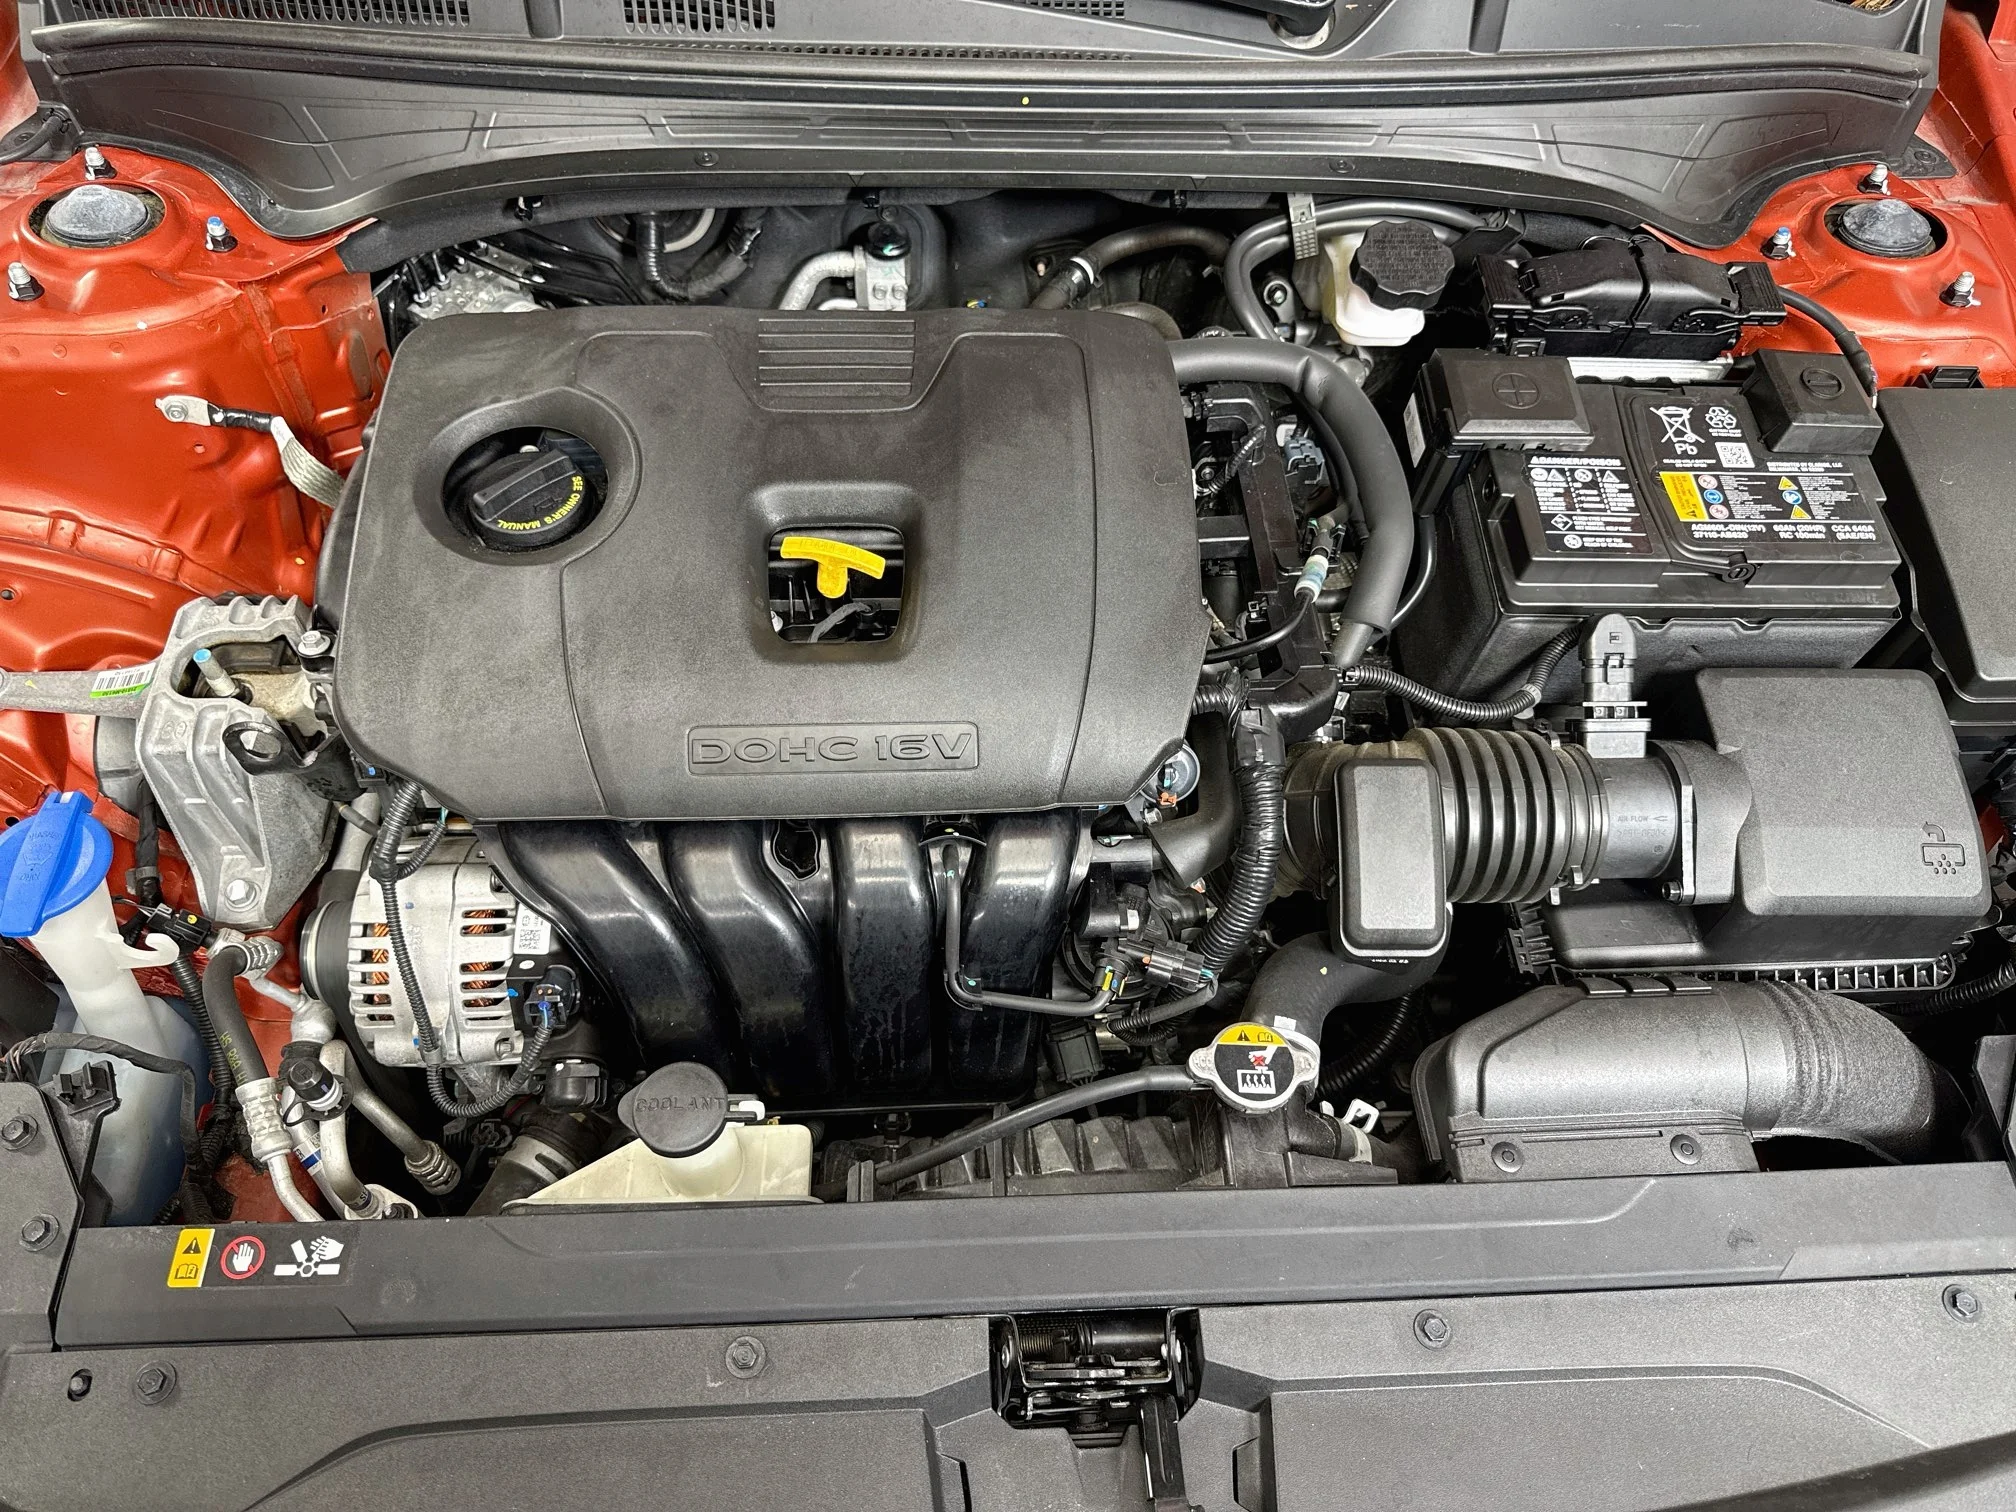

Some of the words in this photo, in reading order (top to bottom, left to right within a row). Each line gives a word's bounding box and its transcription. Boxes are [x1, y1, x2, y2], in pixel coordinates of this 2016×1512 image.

[1675, 443, 1698, 455] Pb
[572, 476, 584, 491] SEE
[544, 493, 581, 525] OWNER'S
[497, 520, 541, 530] MANUAL
[692, 736, 859, 764] DOHC
[875, 733, 972, 760] 16V
[219, 1031, 233, 1047] HS
[226, 1049, 242, 1071] R&A
[636, 1096, 725, 1112] COOLANT
